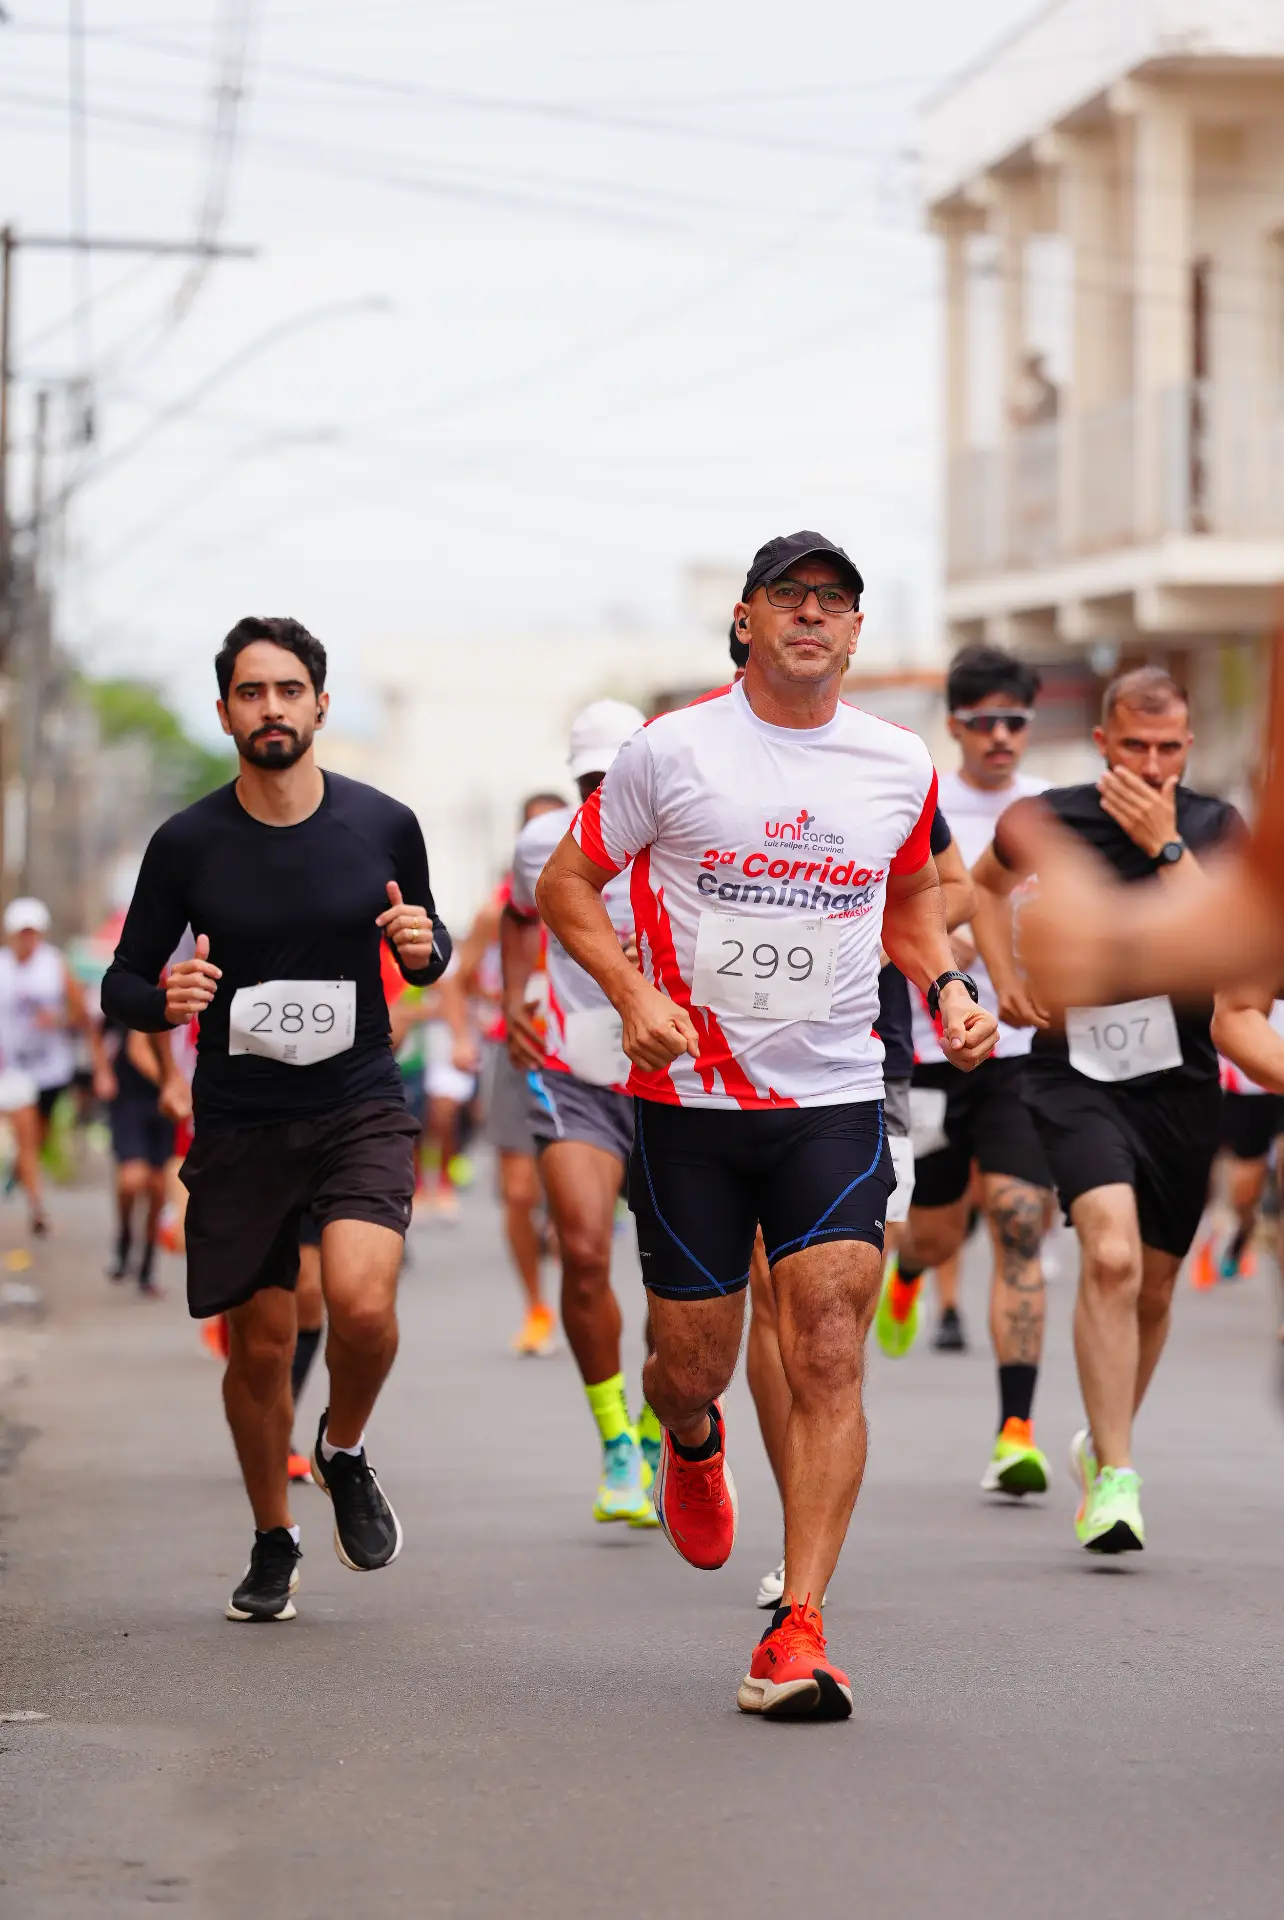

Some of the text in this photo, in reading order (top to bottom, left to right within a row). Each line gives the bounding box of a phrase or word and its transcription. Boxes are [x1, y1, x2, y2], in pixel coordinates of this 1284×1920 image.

[764, 840, 778, 848] Luiz
[780, 841, 802, 850] Felipe
[812, 844, 844, 854] Cruvinel
[742, 853, 873, 887] Corrida
[717, 940, 813, 981] 299
[250, 1002, 335, 1034] 289
[1088, 1017, 1150, 1052] 107
